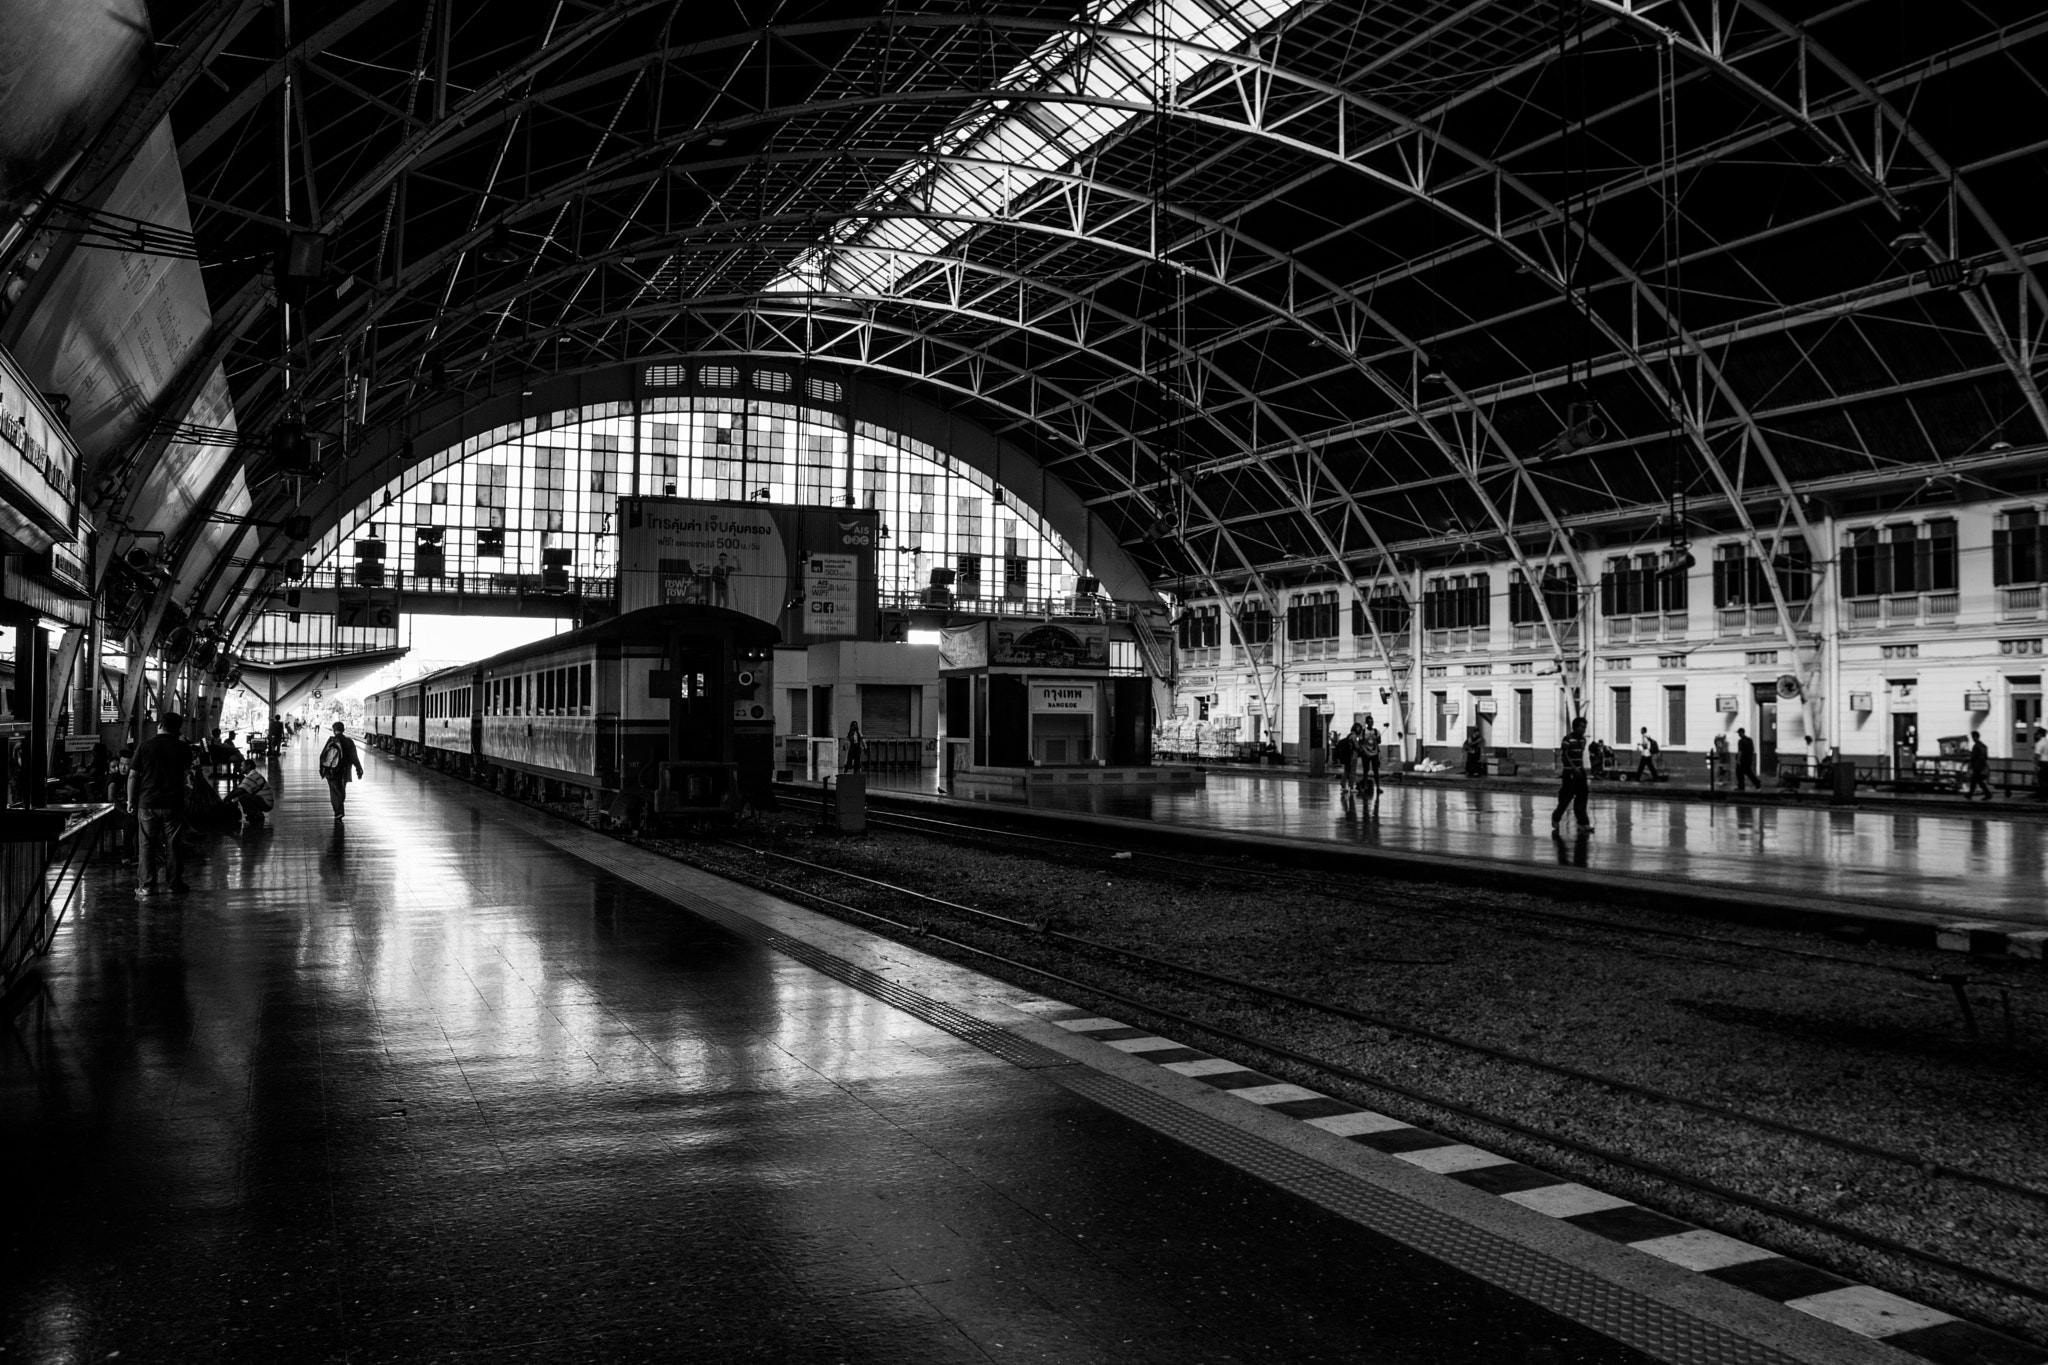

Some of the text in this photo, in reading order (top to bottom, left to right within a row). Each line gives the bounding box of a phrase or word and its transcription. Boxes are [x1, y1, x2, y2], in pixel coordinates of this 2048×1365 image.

[647, 513, 771, 537] โทรคุ้มค่า เจ็บคุ้มครอง
[853, 526, 870, 535] AIS
[716, 537, 740, 549] 500
[345, 606, 361, 625] 7
[377, 609, 392, 626] 6
[890, 623, 903, 638] 4
[237, 689, 246, 698] 7
[313, 690, 322, 699] 6
[1044, 689, 1082, 701] กรุงเทพ
